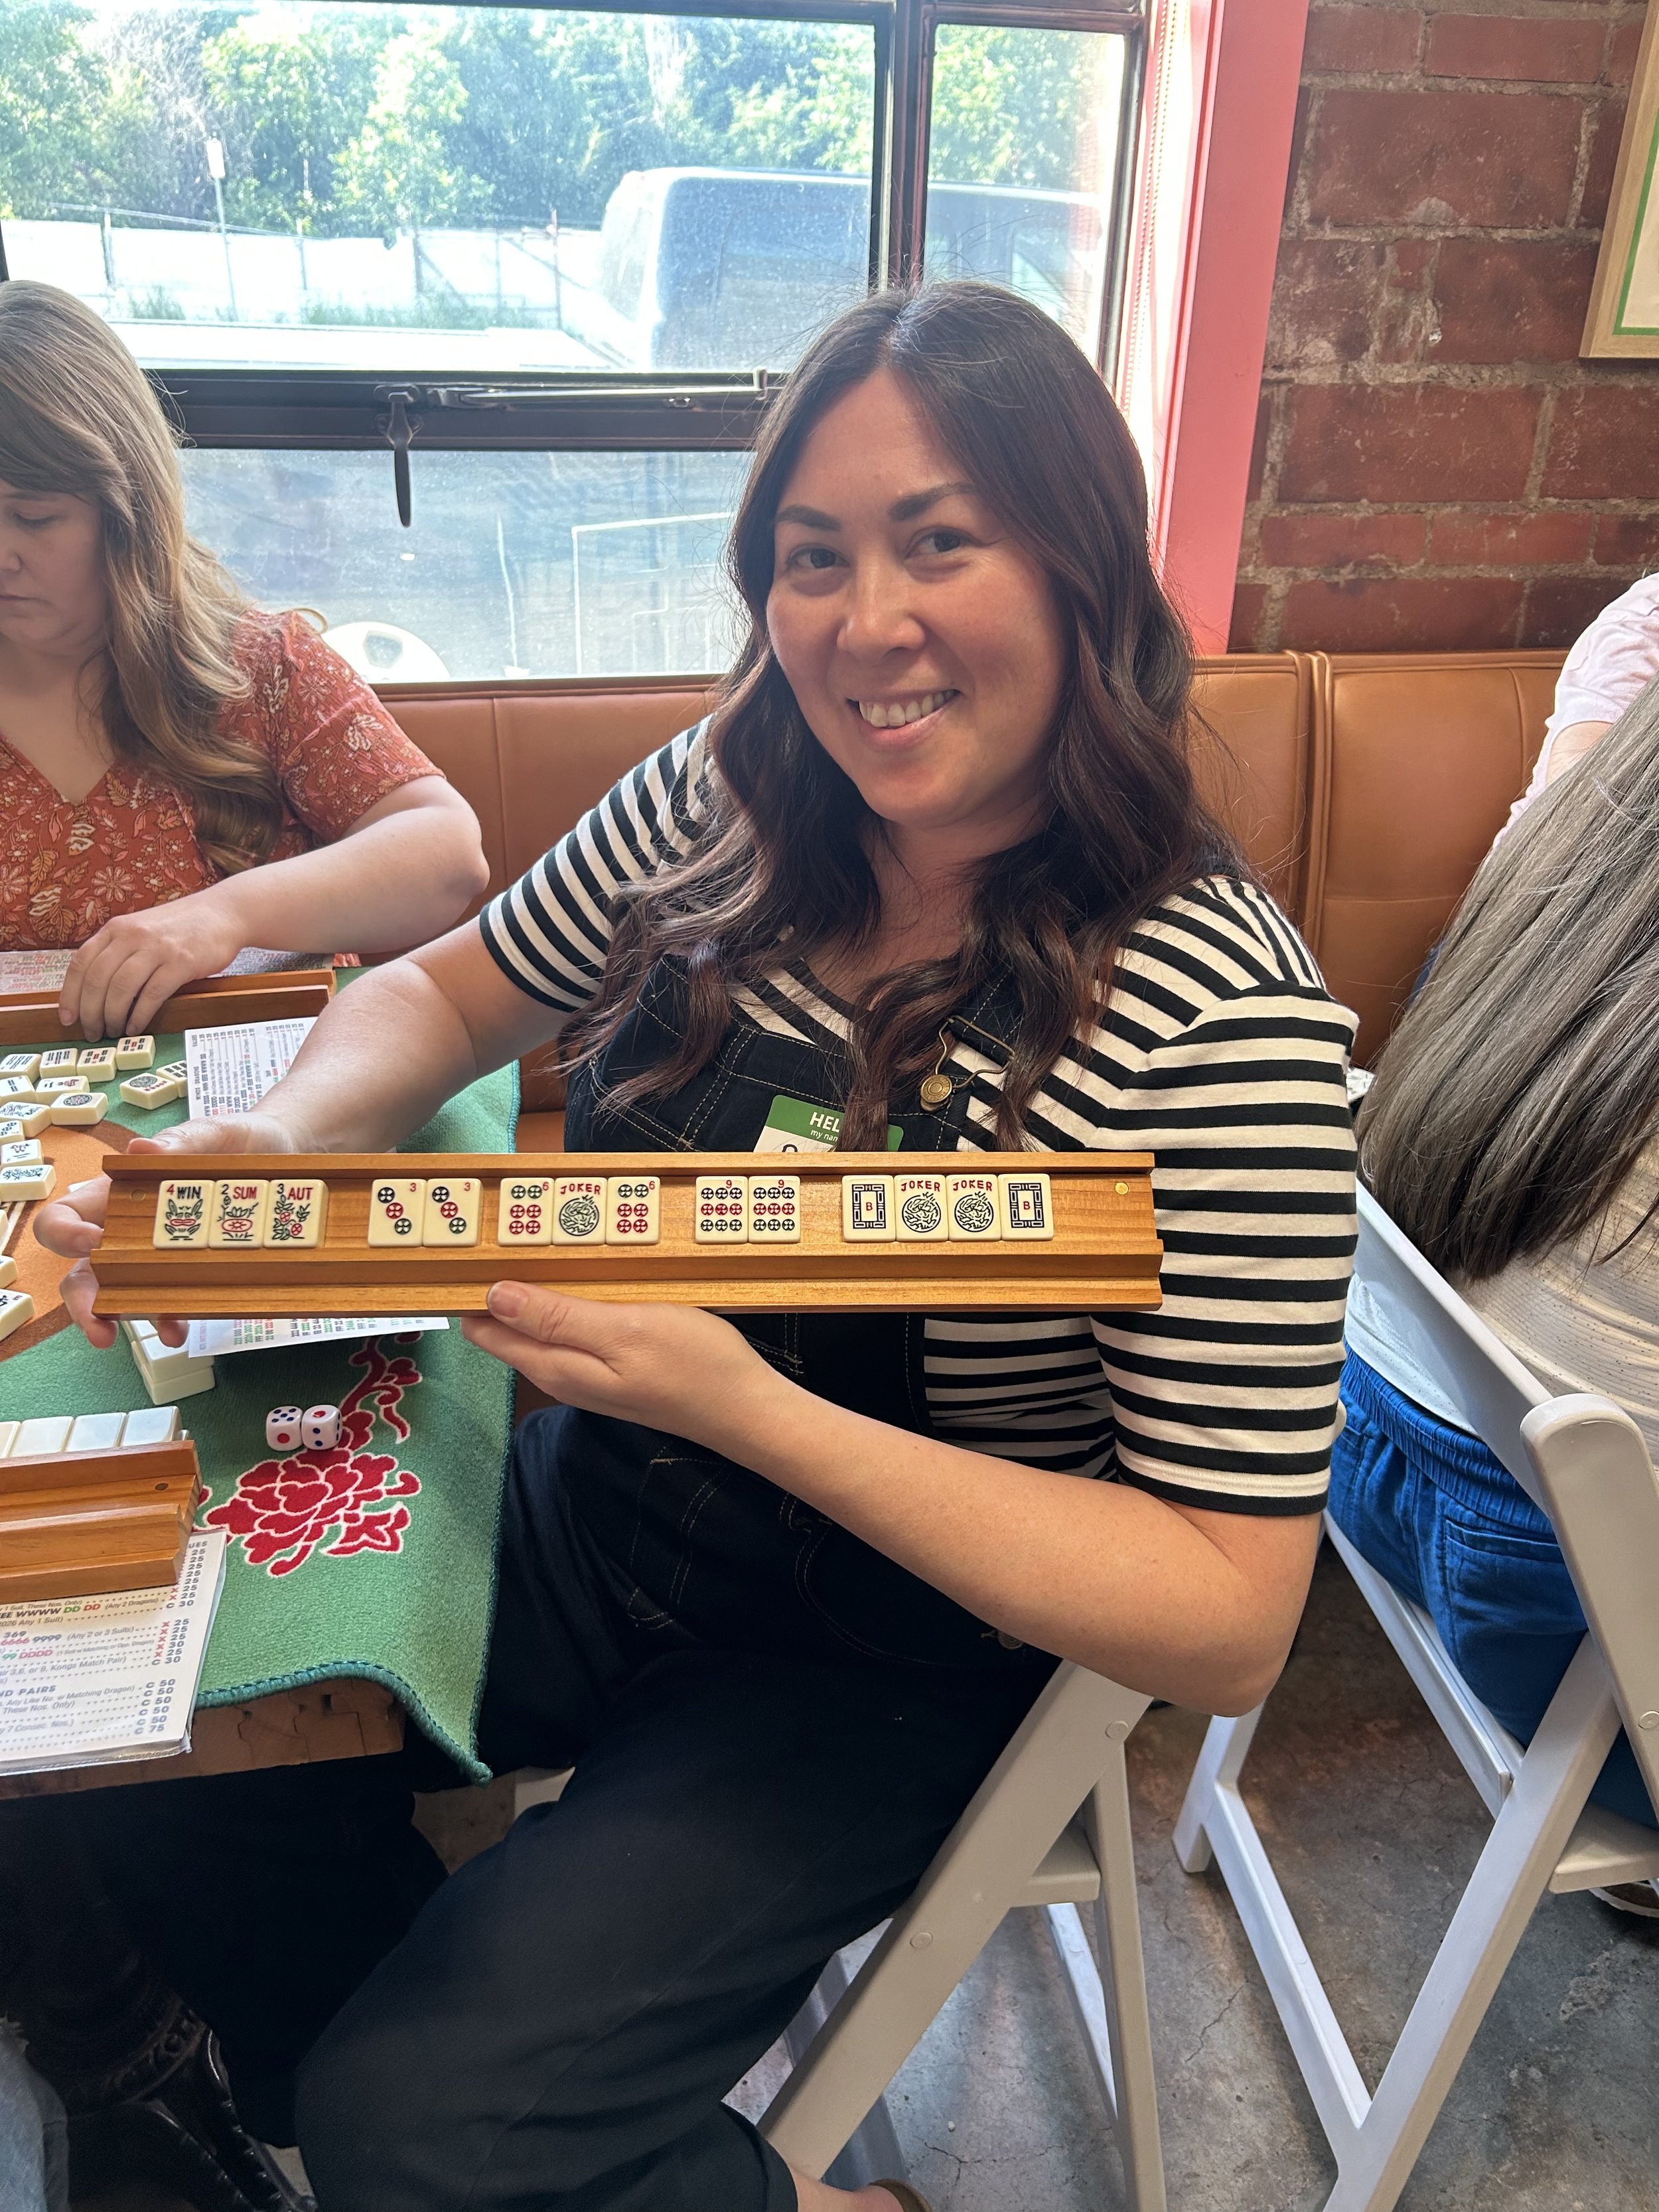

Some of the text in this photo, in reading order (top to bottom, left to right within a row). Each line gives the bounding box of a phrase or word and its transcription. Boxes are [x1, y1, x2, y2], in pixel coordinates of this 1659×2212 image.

[810, 1112, 840, 1133] HEL
[810, 1130, 823, 1139] my
[409, 1183, 417, 1192] 3
[464, 1182, 471, 1191] 3
[542, 1181, 549, 1191] 6
[559, 1183, 601, 1195] JOKER
[648, 1181, 656, 1191] 6
[725, 1179, 733, 1189] 9
[778, 1179, 785, 1189] 9
[901, 1180, 941, 1192] JOKER
[952, 1180, 993, 1191] JOKER
[167, 1184, 202, 1199] 4 WIN
[221, 1184, 257, 1199] 2 SUM
[277, 1183, 314, 1200] 3 AUT
[865, 1202, 873, 1211] B
[1023, 1201, 1031, 1210] B
[16, 1607, 62, 1617] WWWW
[63, 1605, 81, 1614] DD
[128, 1597, 159, 1606] Dragons)
[67, 1633, 86, 1641] (Any
[111, 1626, 135, 1635] Suits)
[50, 1662, 77, 1672] Kongs
[80, 1659, 105, 1668] Match
[106, 1656, 127, 1664] Pair)
[167, 1648, 182, 1657] 25
[165, 1656, 181, 1664] 30
[18, 1685, 57, 1696] PAIRS
[66, 1689, 102, 1699] Matching
[104, 1686, 135, 1695] Dragon)
[159, 1678, 176, 1687] 50
[52, 1700, 76, 1709] Only)
[157, 1686, 174, 1695] 50
[155, 1696, 172, 1705] 50
[153, 1706, 170, 1714] 50
[151, 1715, 168, 1724] 50
[149, 1724, 165, 1733] 75
